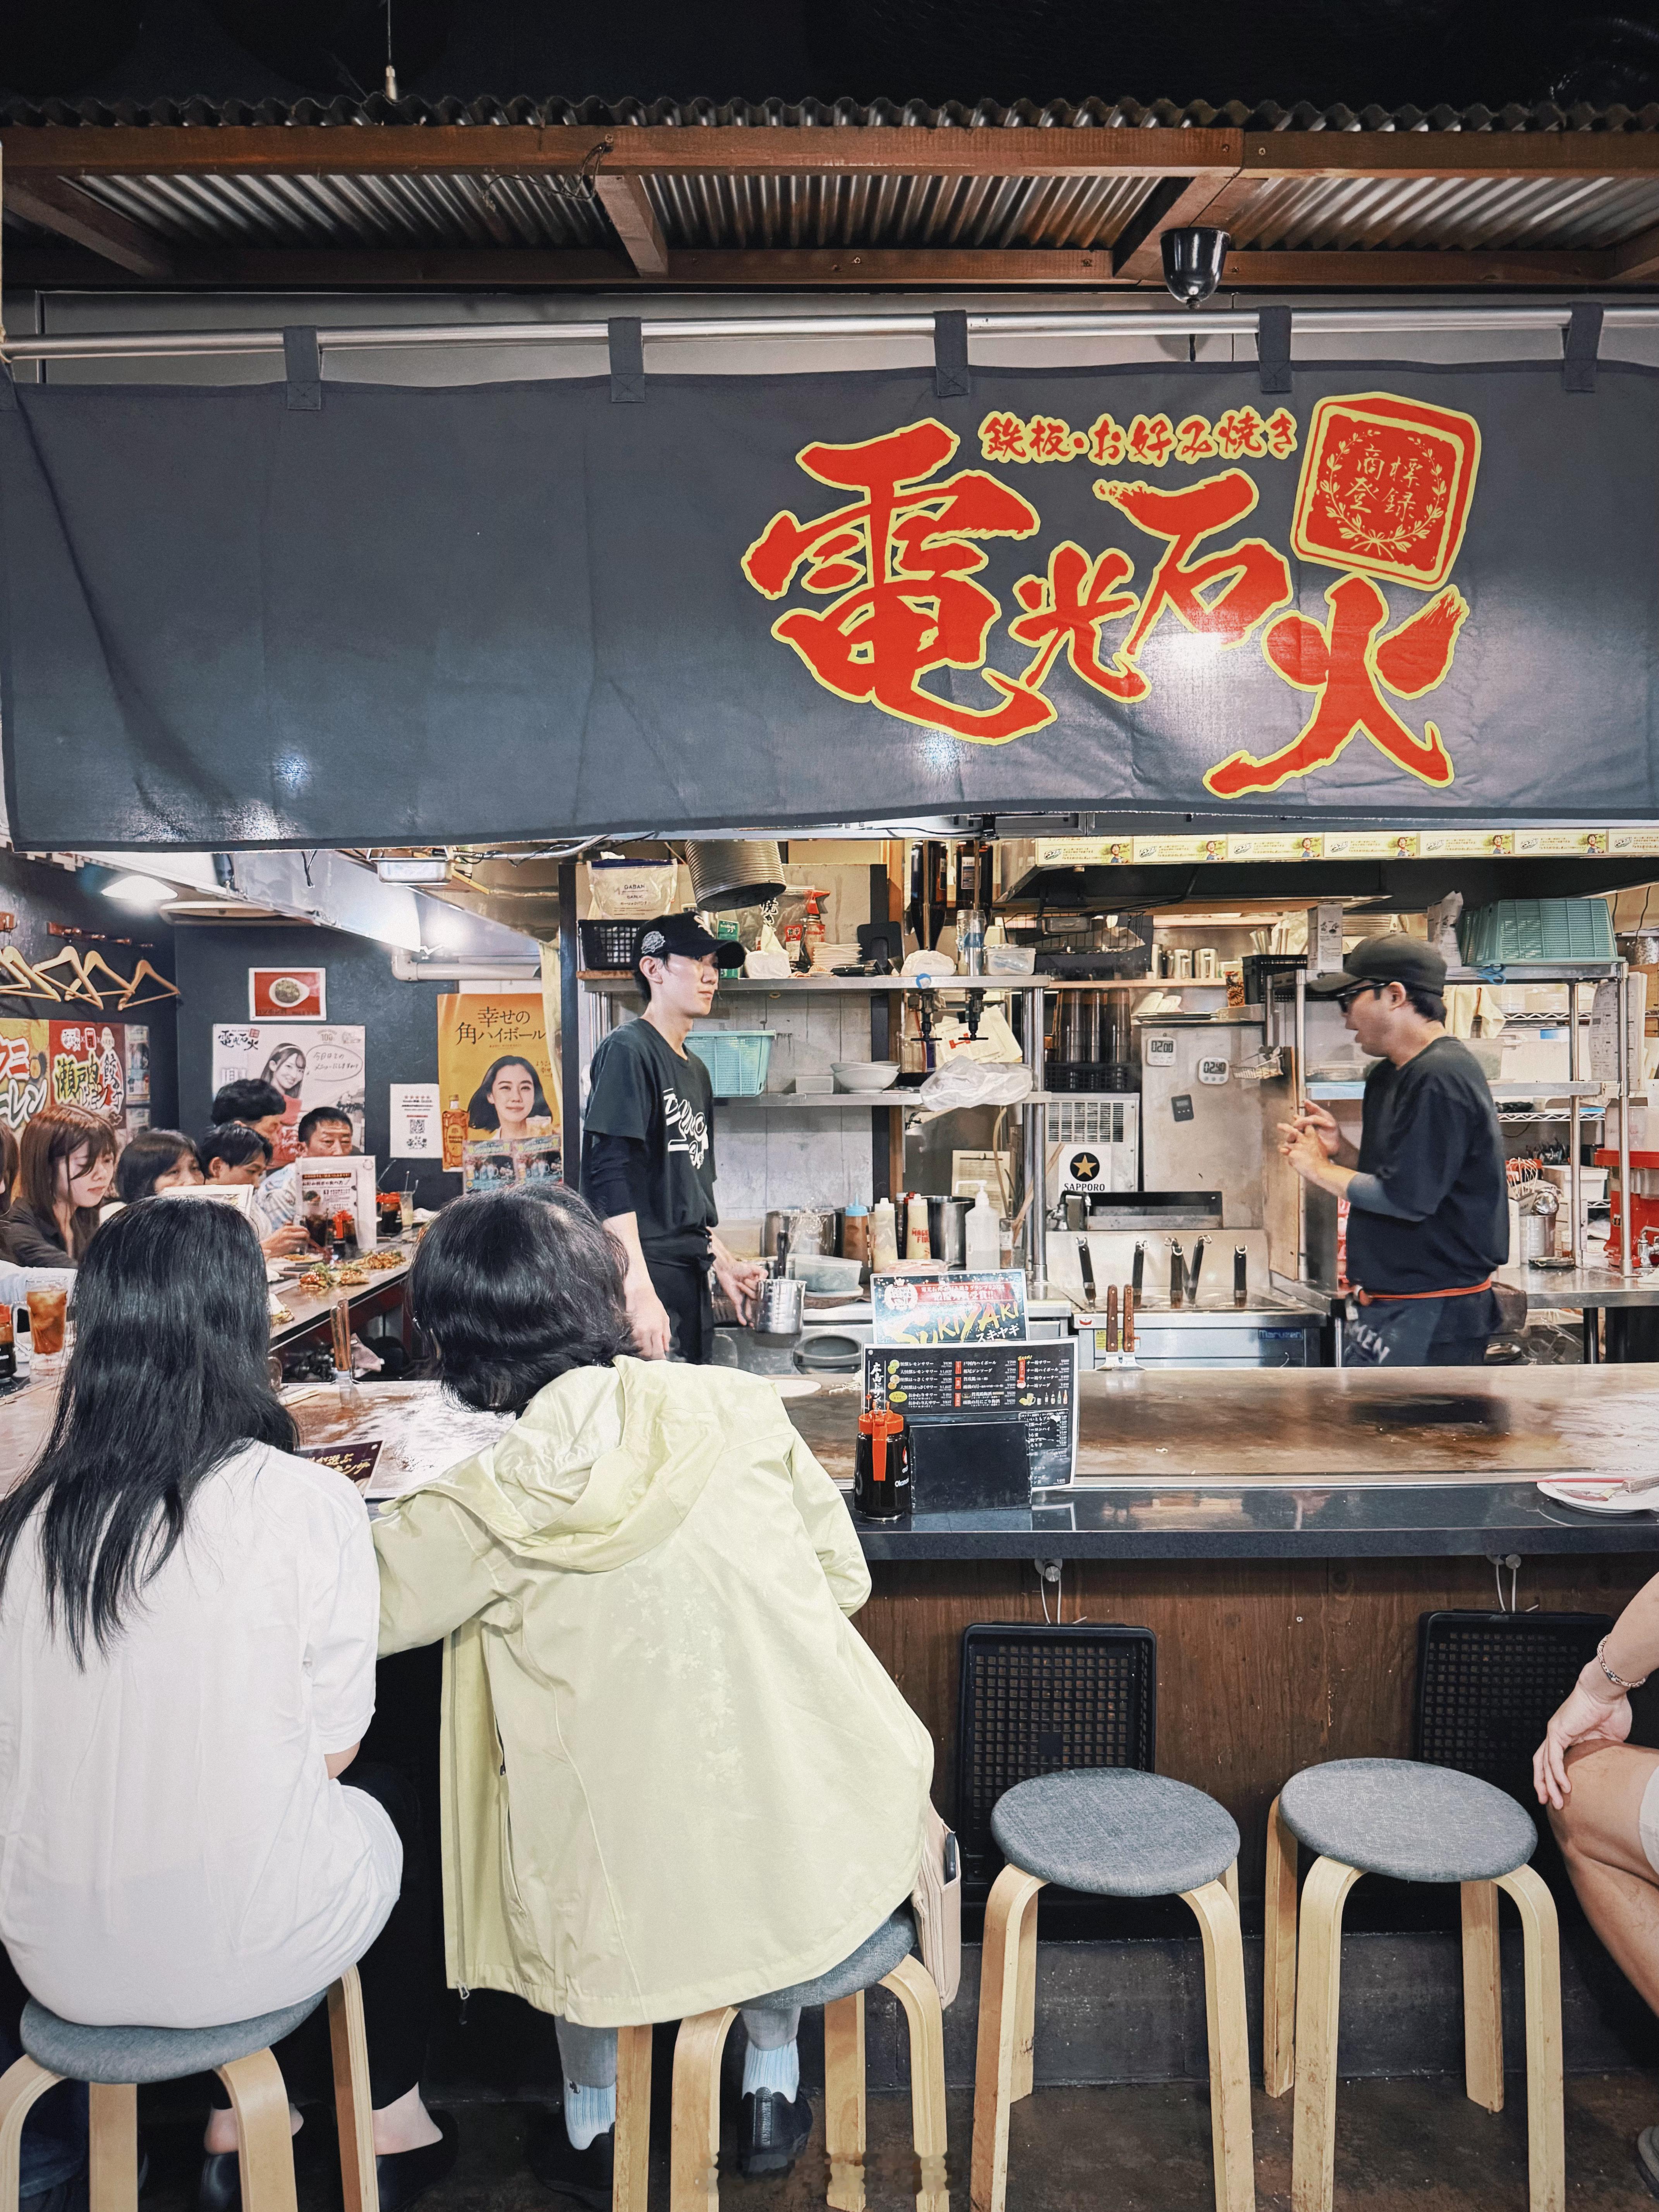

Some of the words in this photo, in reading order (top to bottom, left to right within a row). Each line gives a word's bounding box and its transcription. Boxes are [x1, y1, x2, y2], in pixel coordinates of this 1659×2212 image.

[979, 406, 1297, 467] 鉄板・お好み焼き
[742, 417, 1470, 798] 電光石火
[477, 1006, 530, 1027] 幸せの
[455, 1022, 546, 1045] 角ハイボール
[1064, 1183, 1105, 1191] SAPPORO
